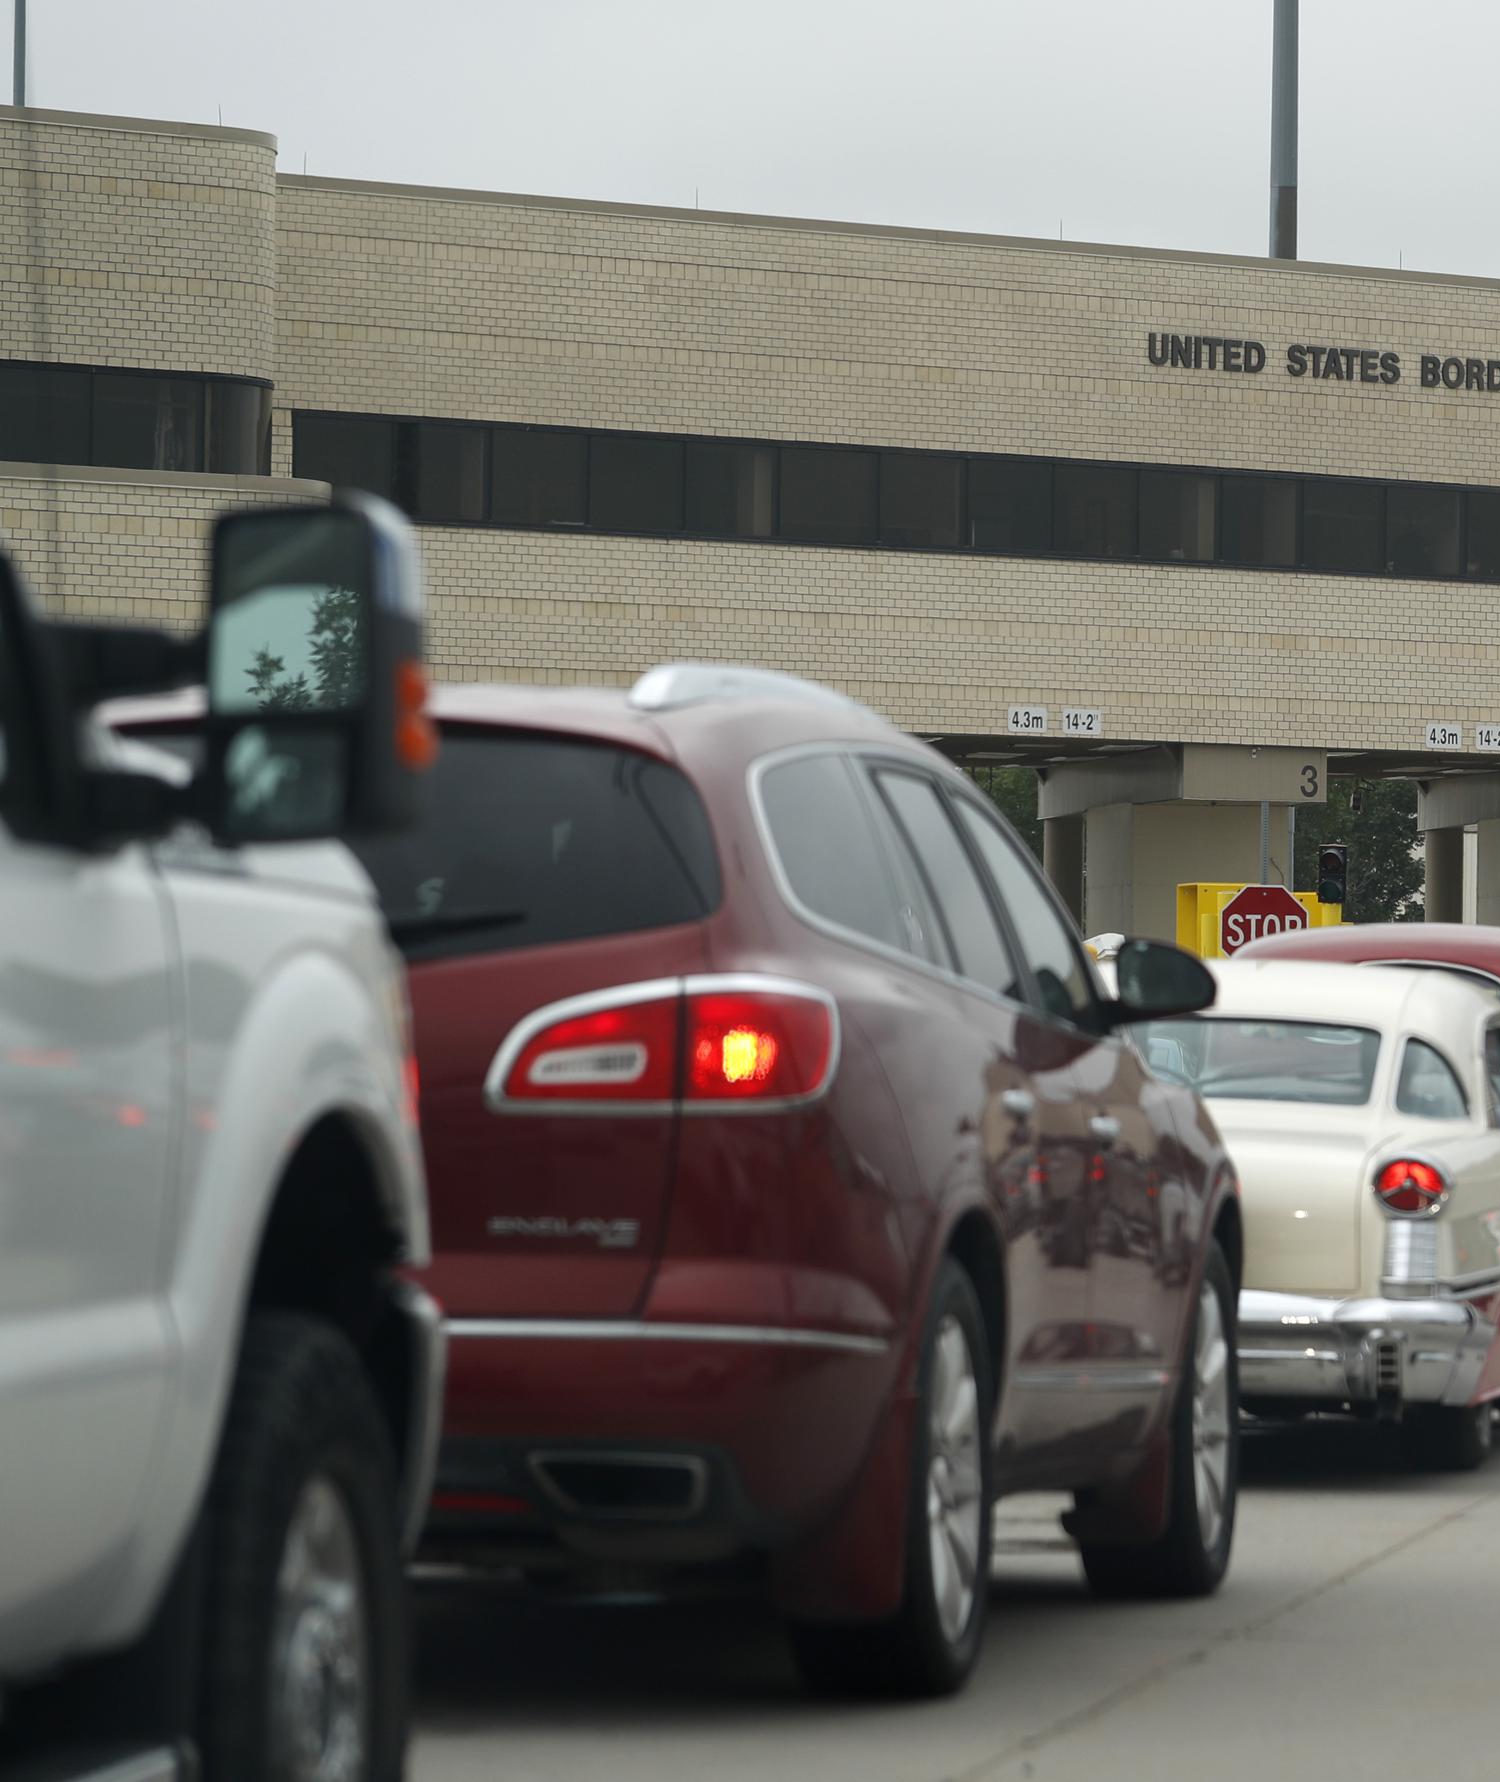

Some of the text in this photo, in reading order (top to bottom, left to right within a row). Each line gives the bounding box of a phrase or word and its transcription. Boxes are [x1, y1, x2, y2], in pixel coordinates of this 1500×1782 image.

[1147, 332, 1267, 375] UNITED
[1286, 344, 1401, 385] STATES
[1012, 711, 1044, 731] 4.3m
[1428, 726, 1459, 747] 4.3m
[1299, 764, 1319, 798] 3
